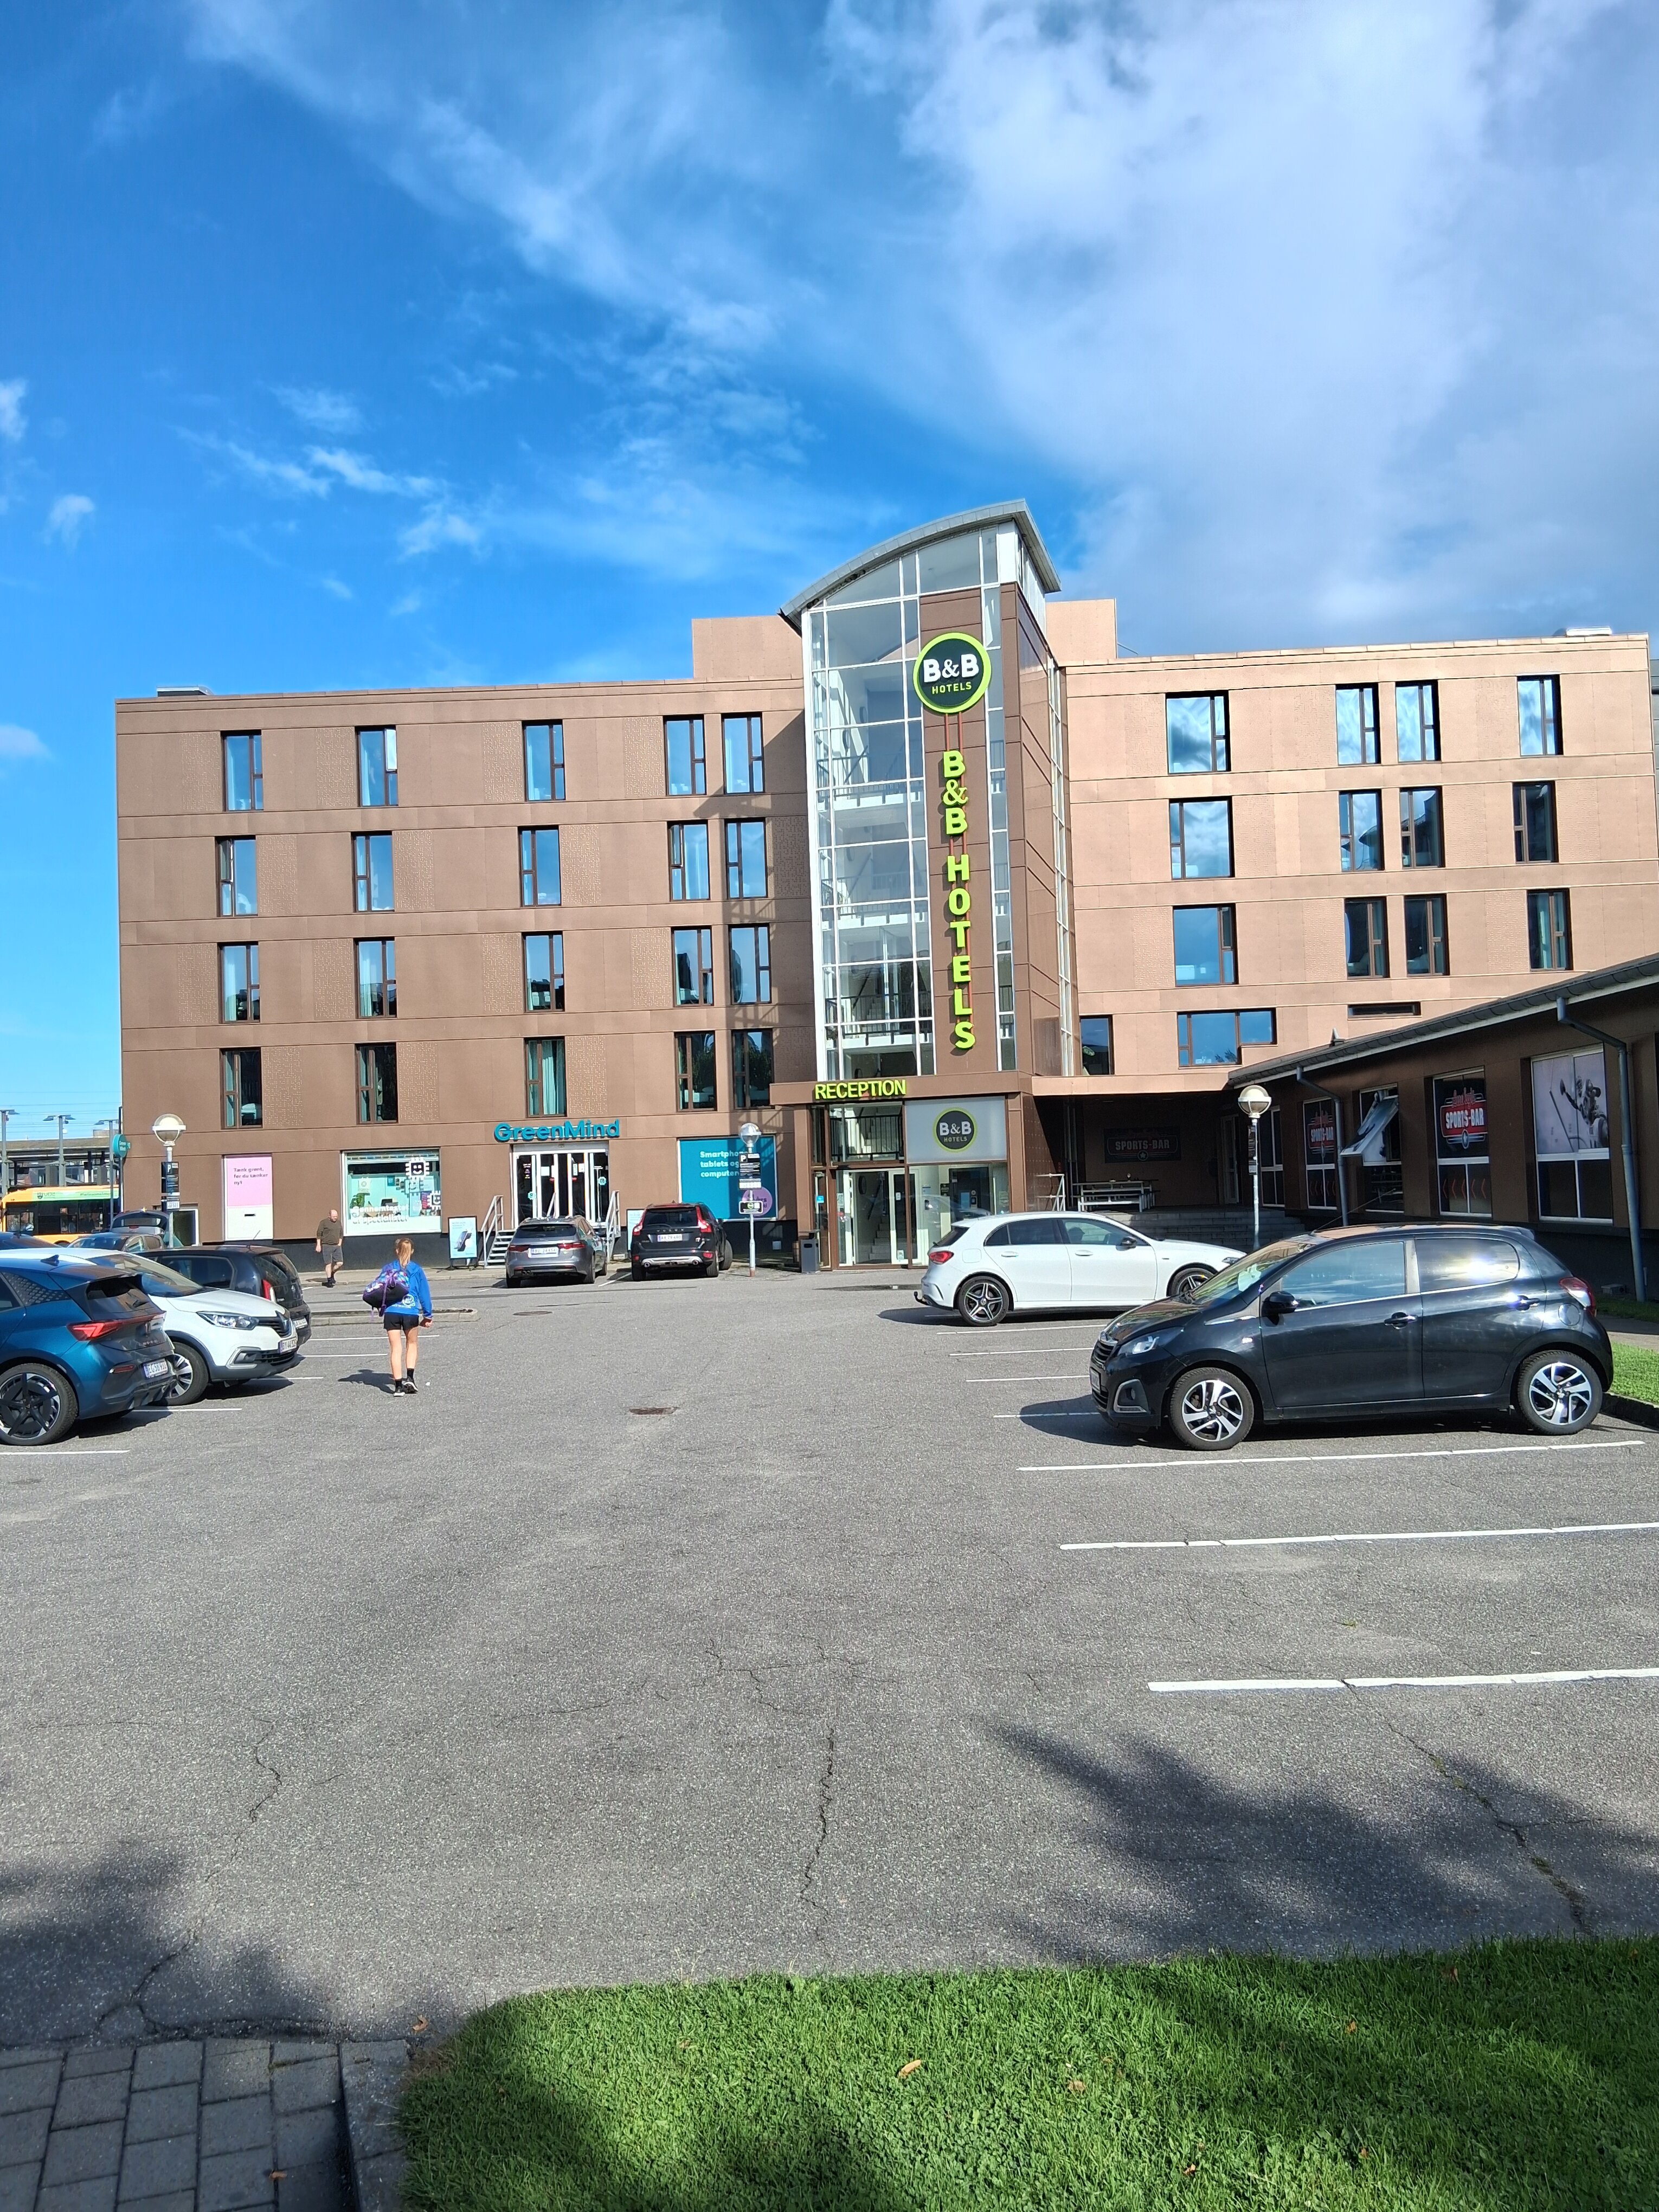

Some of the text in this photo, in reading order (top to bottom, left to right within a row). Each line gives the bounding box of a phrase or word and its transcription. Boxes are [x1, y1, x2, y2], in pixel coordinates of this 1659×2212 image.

[923, 653, 979, 683] B&B
[931, 681, 972, 695] HOTELS
[943, 750, 976, 1050] B&B HOTELS
[815, 1079, 906, 1099] RECEPTION
[939, 1121, 972, 1136] B&B
[1445, 1108, 1484, 1129] SPORTS-BAR
[494, 1118, 620, 1142] GreenMind
[1310, 1126, 1334, 1142] SPORTS-BAR
[1115, 1139, 1170, 1150] SPORTS-BAR
